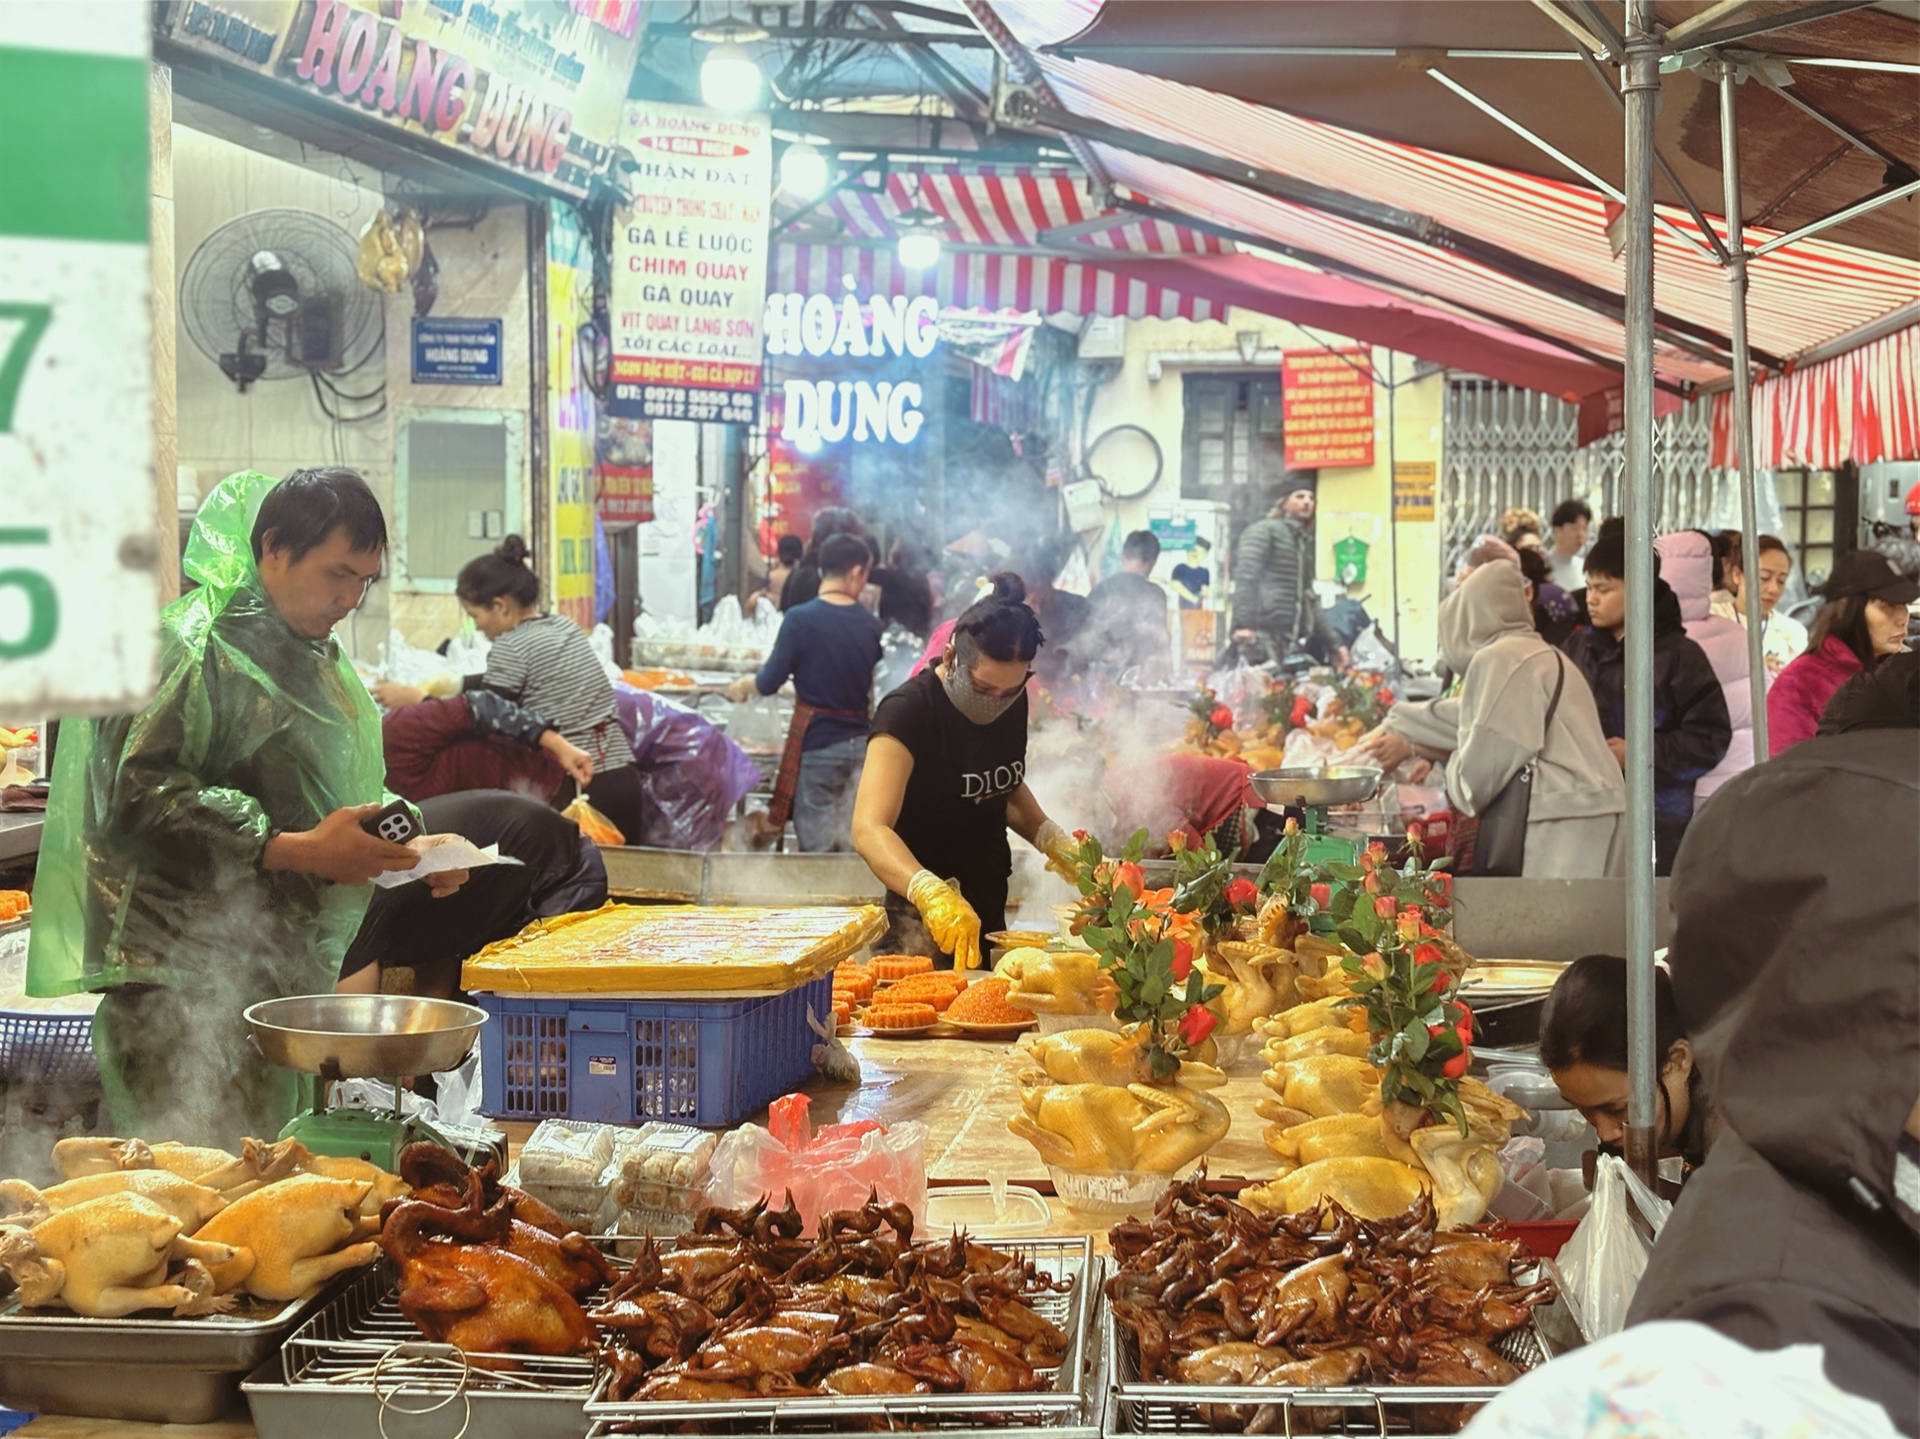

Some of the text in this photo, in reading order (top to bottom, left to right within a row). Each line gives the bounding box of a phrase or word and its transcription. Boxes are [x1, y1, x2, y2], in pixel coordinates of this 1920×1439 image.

[470, 72, 572, 173] DUNG
[628, 223, 656, 246] GÀ
[698, 232, 753, 256] LUỘC
[629, 255, 749, 281] CHIM QUAY
[643, 282, 733, 308] GÀ QUAY
[646, 313, 680, 332] QUAY
[766, 273, 940, 358] HOÀNG
[781, 379, 924, 444] DUNG
[961, 761, 1024, 798] DIOR
